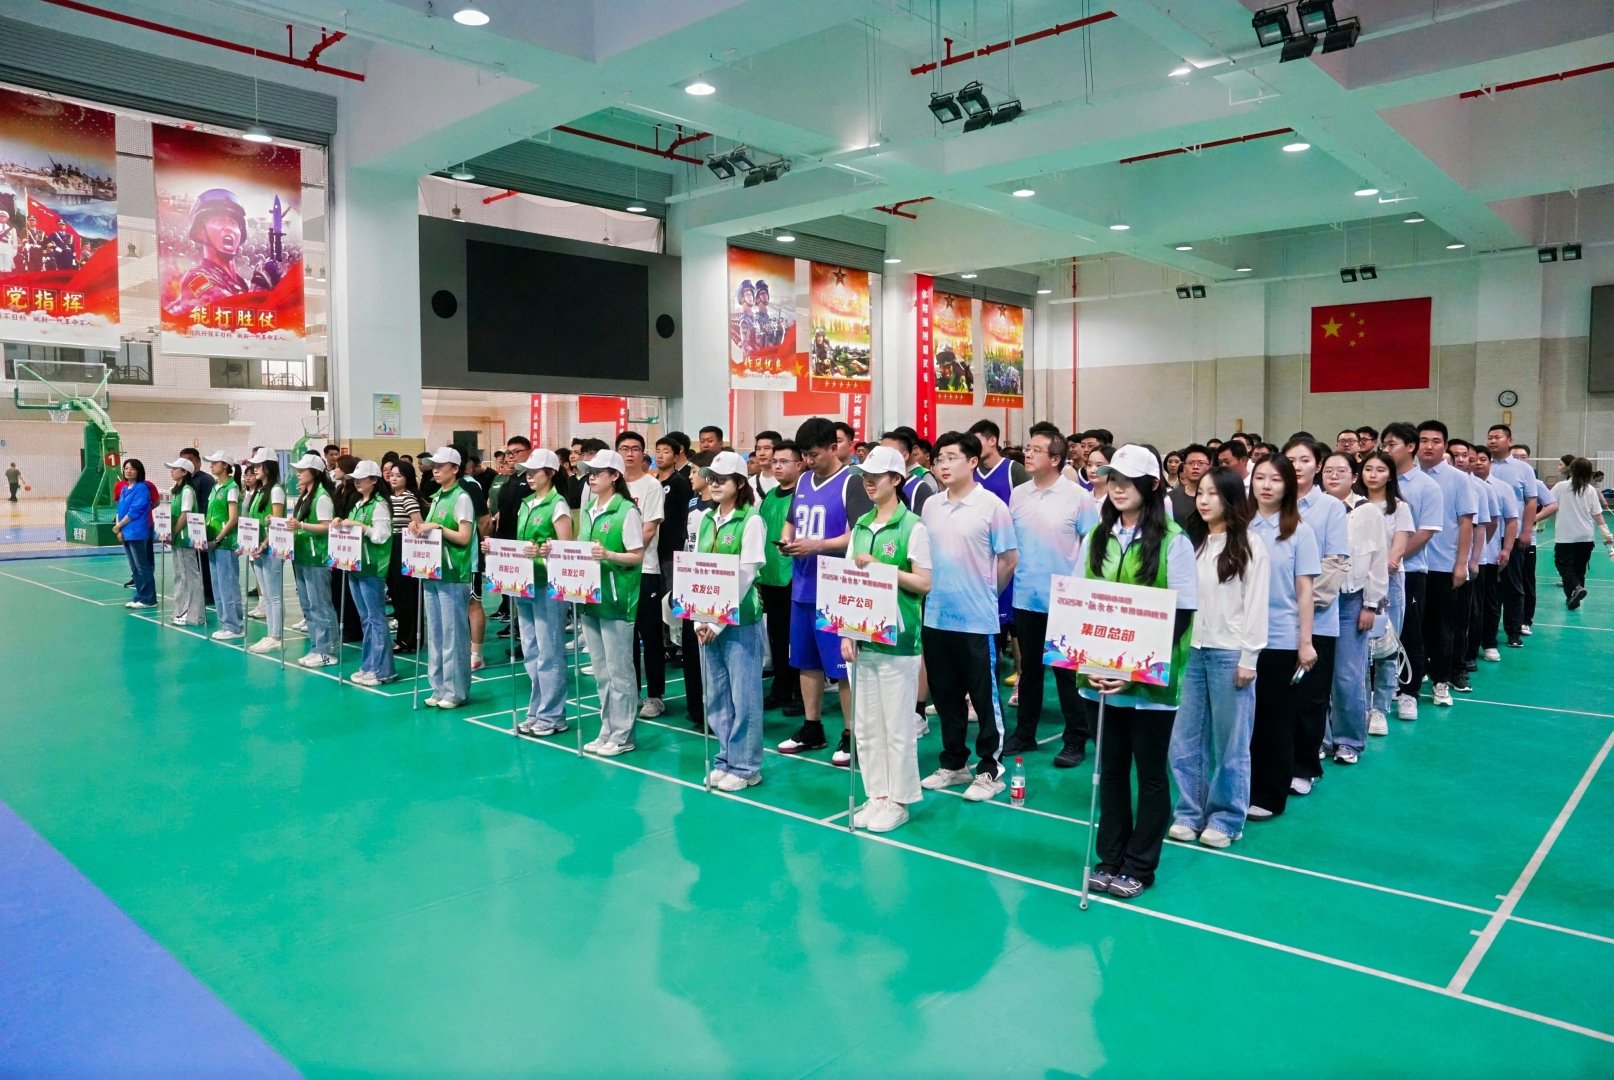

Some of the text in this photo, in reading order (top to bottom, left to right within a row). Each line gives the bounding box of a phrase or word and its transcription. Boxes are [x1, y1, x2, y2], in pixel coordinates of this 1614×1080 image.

[6, 286, 84, 312] 党指挥
[189, 305, 276, 328] 能打胜仗
[853, 394, 862, 441] 比赛第二
[108, 453, 116, 466] 1
[795, 504, 826, 540] 30
[691, 583, 721, 596] 农发公司
[838, 594, 873, 610] 地产公司
[1080, 622, 1136, 643] 集团总部
